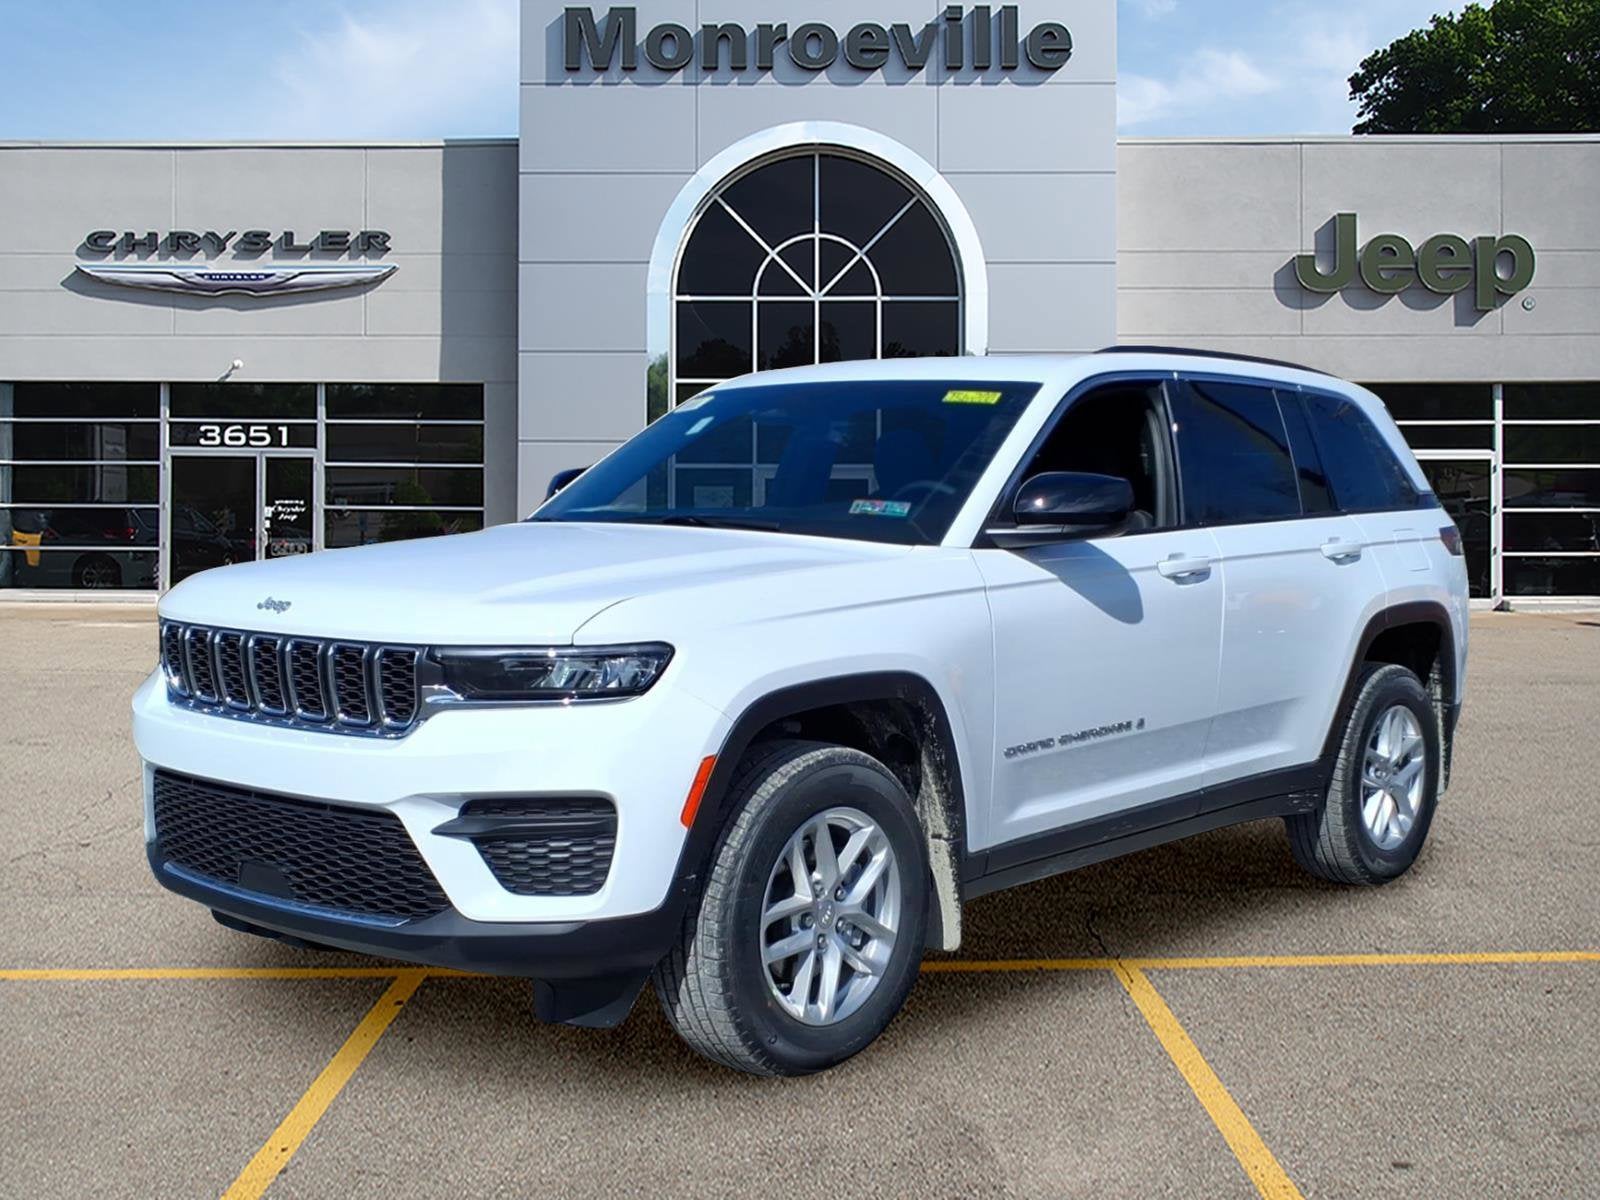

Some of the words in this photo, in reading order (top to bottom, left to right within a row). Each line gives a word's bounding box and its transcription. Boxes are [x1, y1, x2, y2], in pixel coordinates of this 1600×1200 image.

[564, 6, 1073, 71] Monroeville
[86, 231, 391, 251] CHRYSLER
[1295, 213, 1536, 310] Jeep
[199, 425, 288, 446] 3651
[256, 596, 292, 614] Jeep
